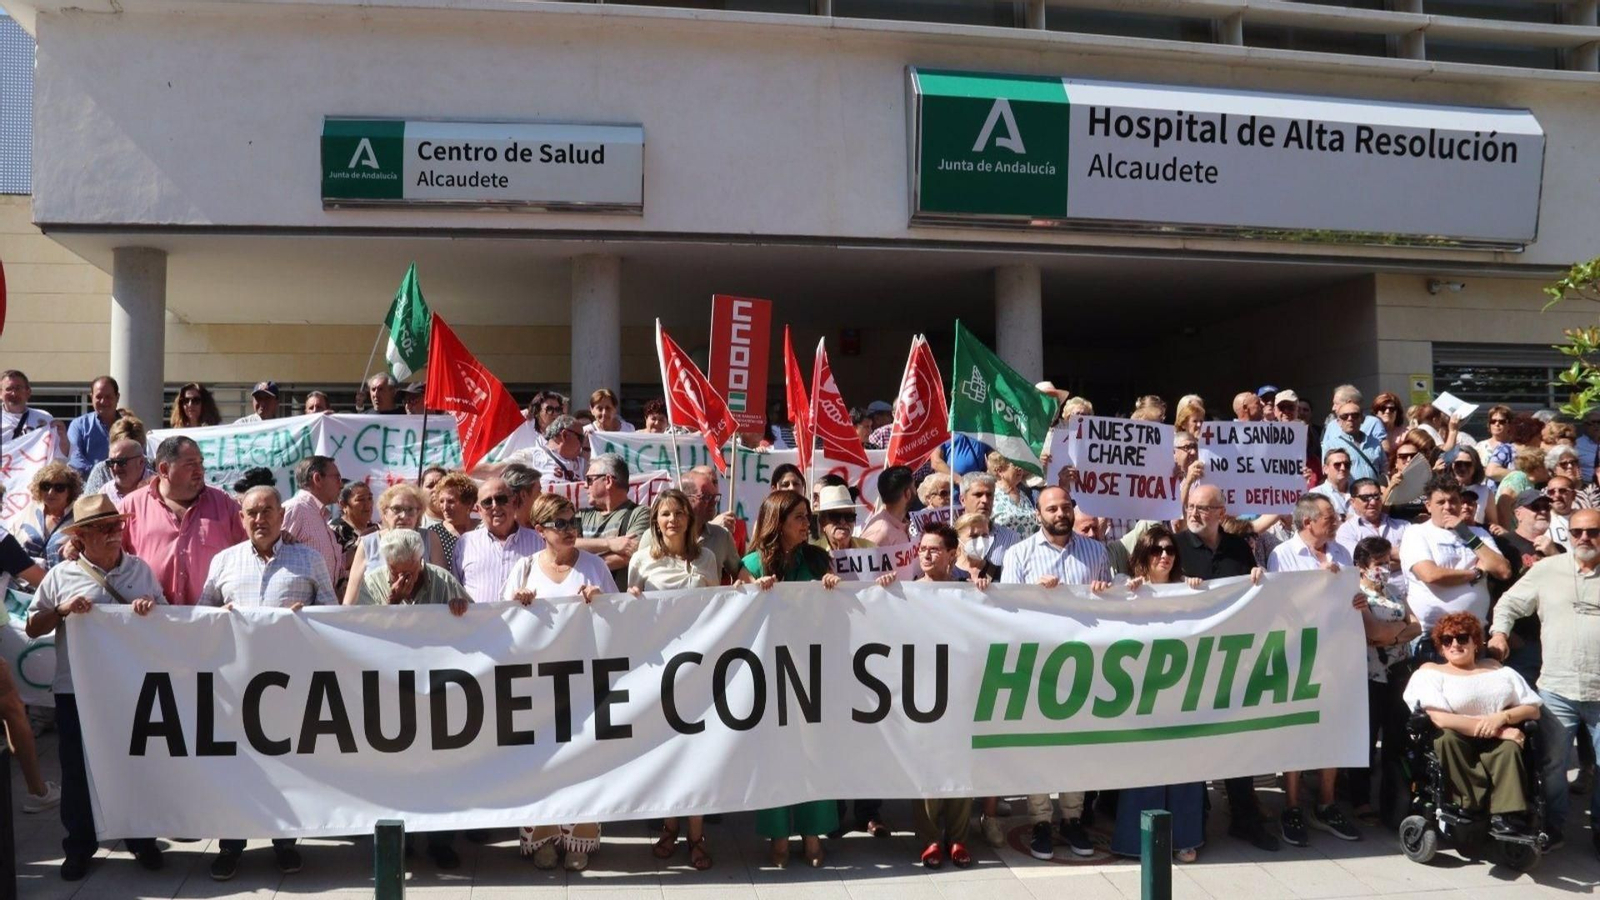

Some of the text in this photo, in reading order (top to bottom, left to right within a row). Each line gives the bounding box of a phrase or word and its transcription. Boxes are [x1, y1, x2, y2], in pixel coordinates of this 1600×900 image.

[1088, 106, 1517, 163] Hospital de Alta Resolución
[417, 140, 605, 165] Centro de Salud
[328, 171, 398, 181] Junta de Andalucía
[417, 170, 509, 188] Alcaudete
[937, 158, 1056, 175] Junta de Andalucía
[1087, 152, 1219, 185] Alcaudete
[729, 299, 753, 390] CCOO
[198, 425, 315, 471] ELEGADA
[1087, 443, 1148, 467] CHARE
[603, 441, 773, 484] CAUTE
[1210, 456, 1304, 475] NO SE VENDE
[1075, 470, 1098, 495] NO
[1098, 472, 1122, 496] SE
[836, 553, 863, 573] EN
[869, 553, 893, 573] LA
[129, 656, 633, 757] ALCAUDETE
[660, 643, 823, 736] CON
[851, 642, 950, 724] SU
[971, 626, 1322, 723] HOSPITAL
